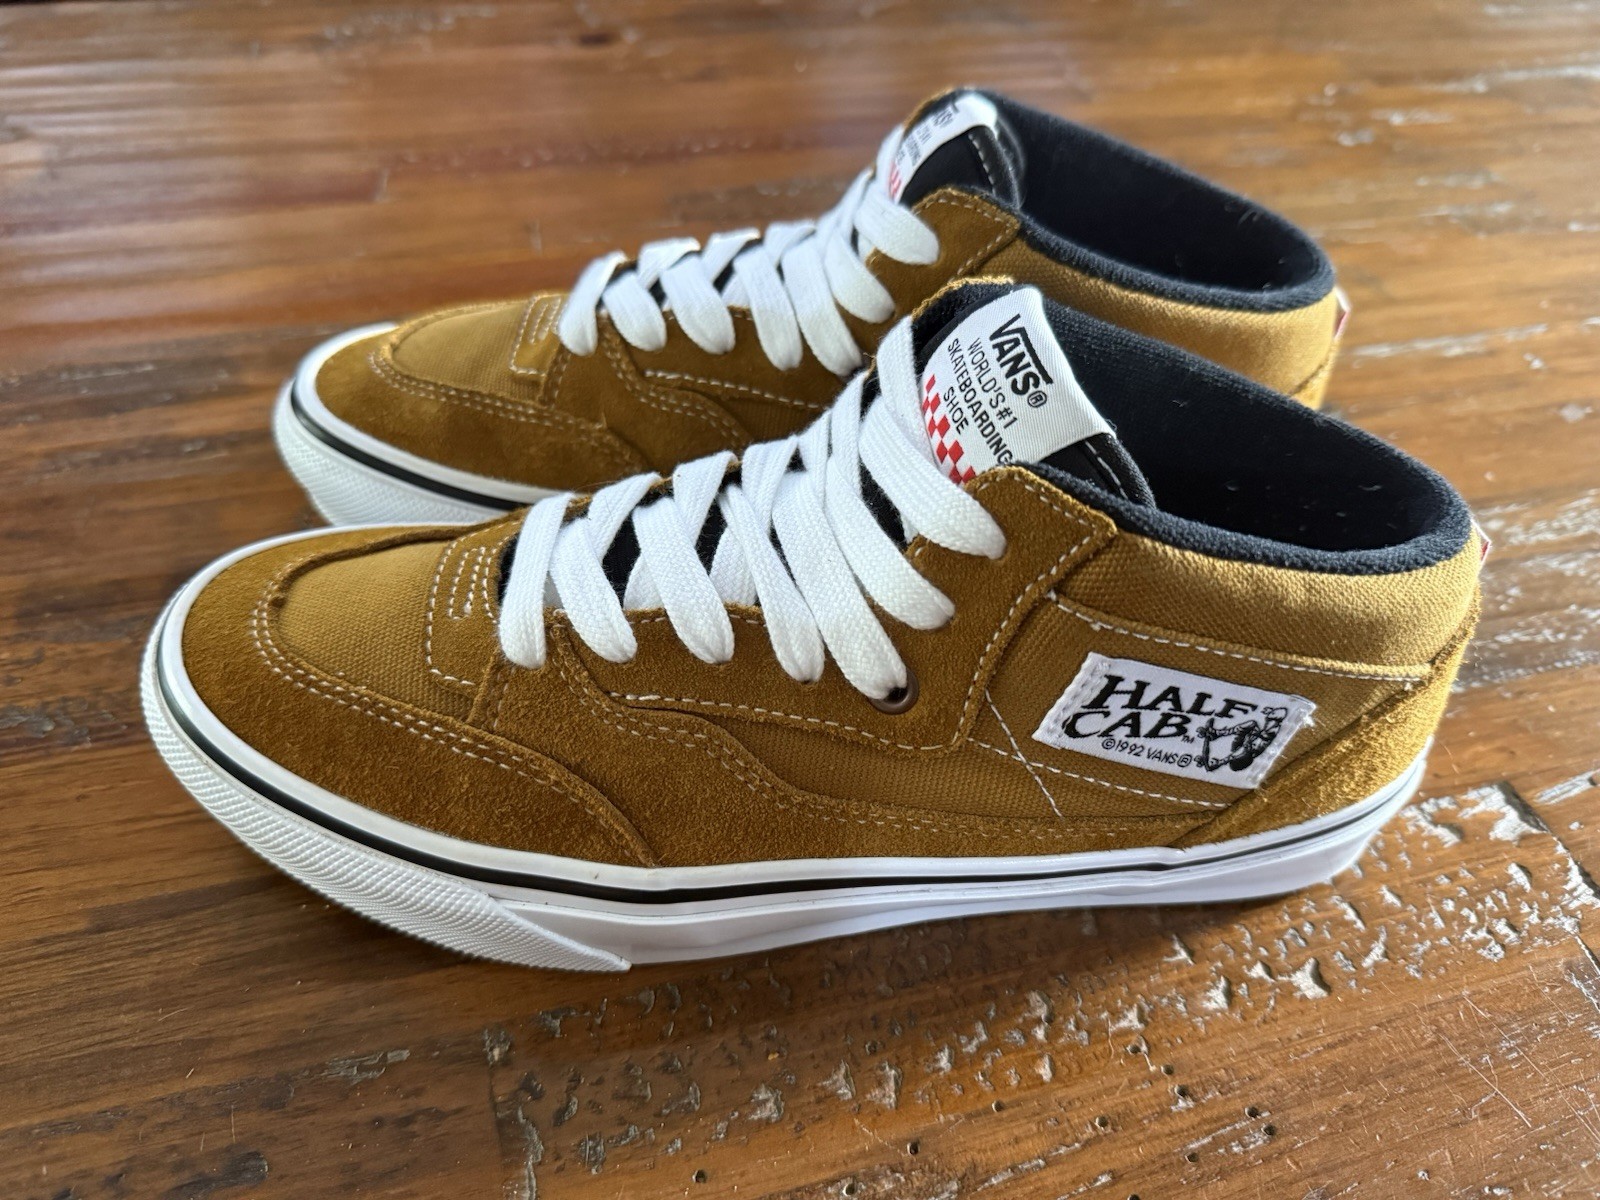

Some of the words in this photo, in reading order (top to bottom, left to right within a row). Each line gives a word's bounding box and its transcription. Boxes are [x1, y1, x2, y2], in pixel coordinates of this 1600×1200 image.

[943, 386, 969, 435] SHOE
[947, 338, 1013, 466] SKATEBOARDING
[1081, 674, 1258, 718] HALF
